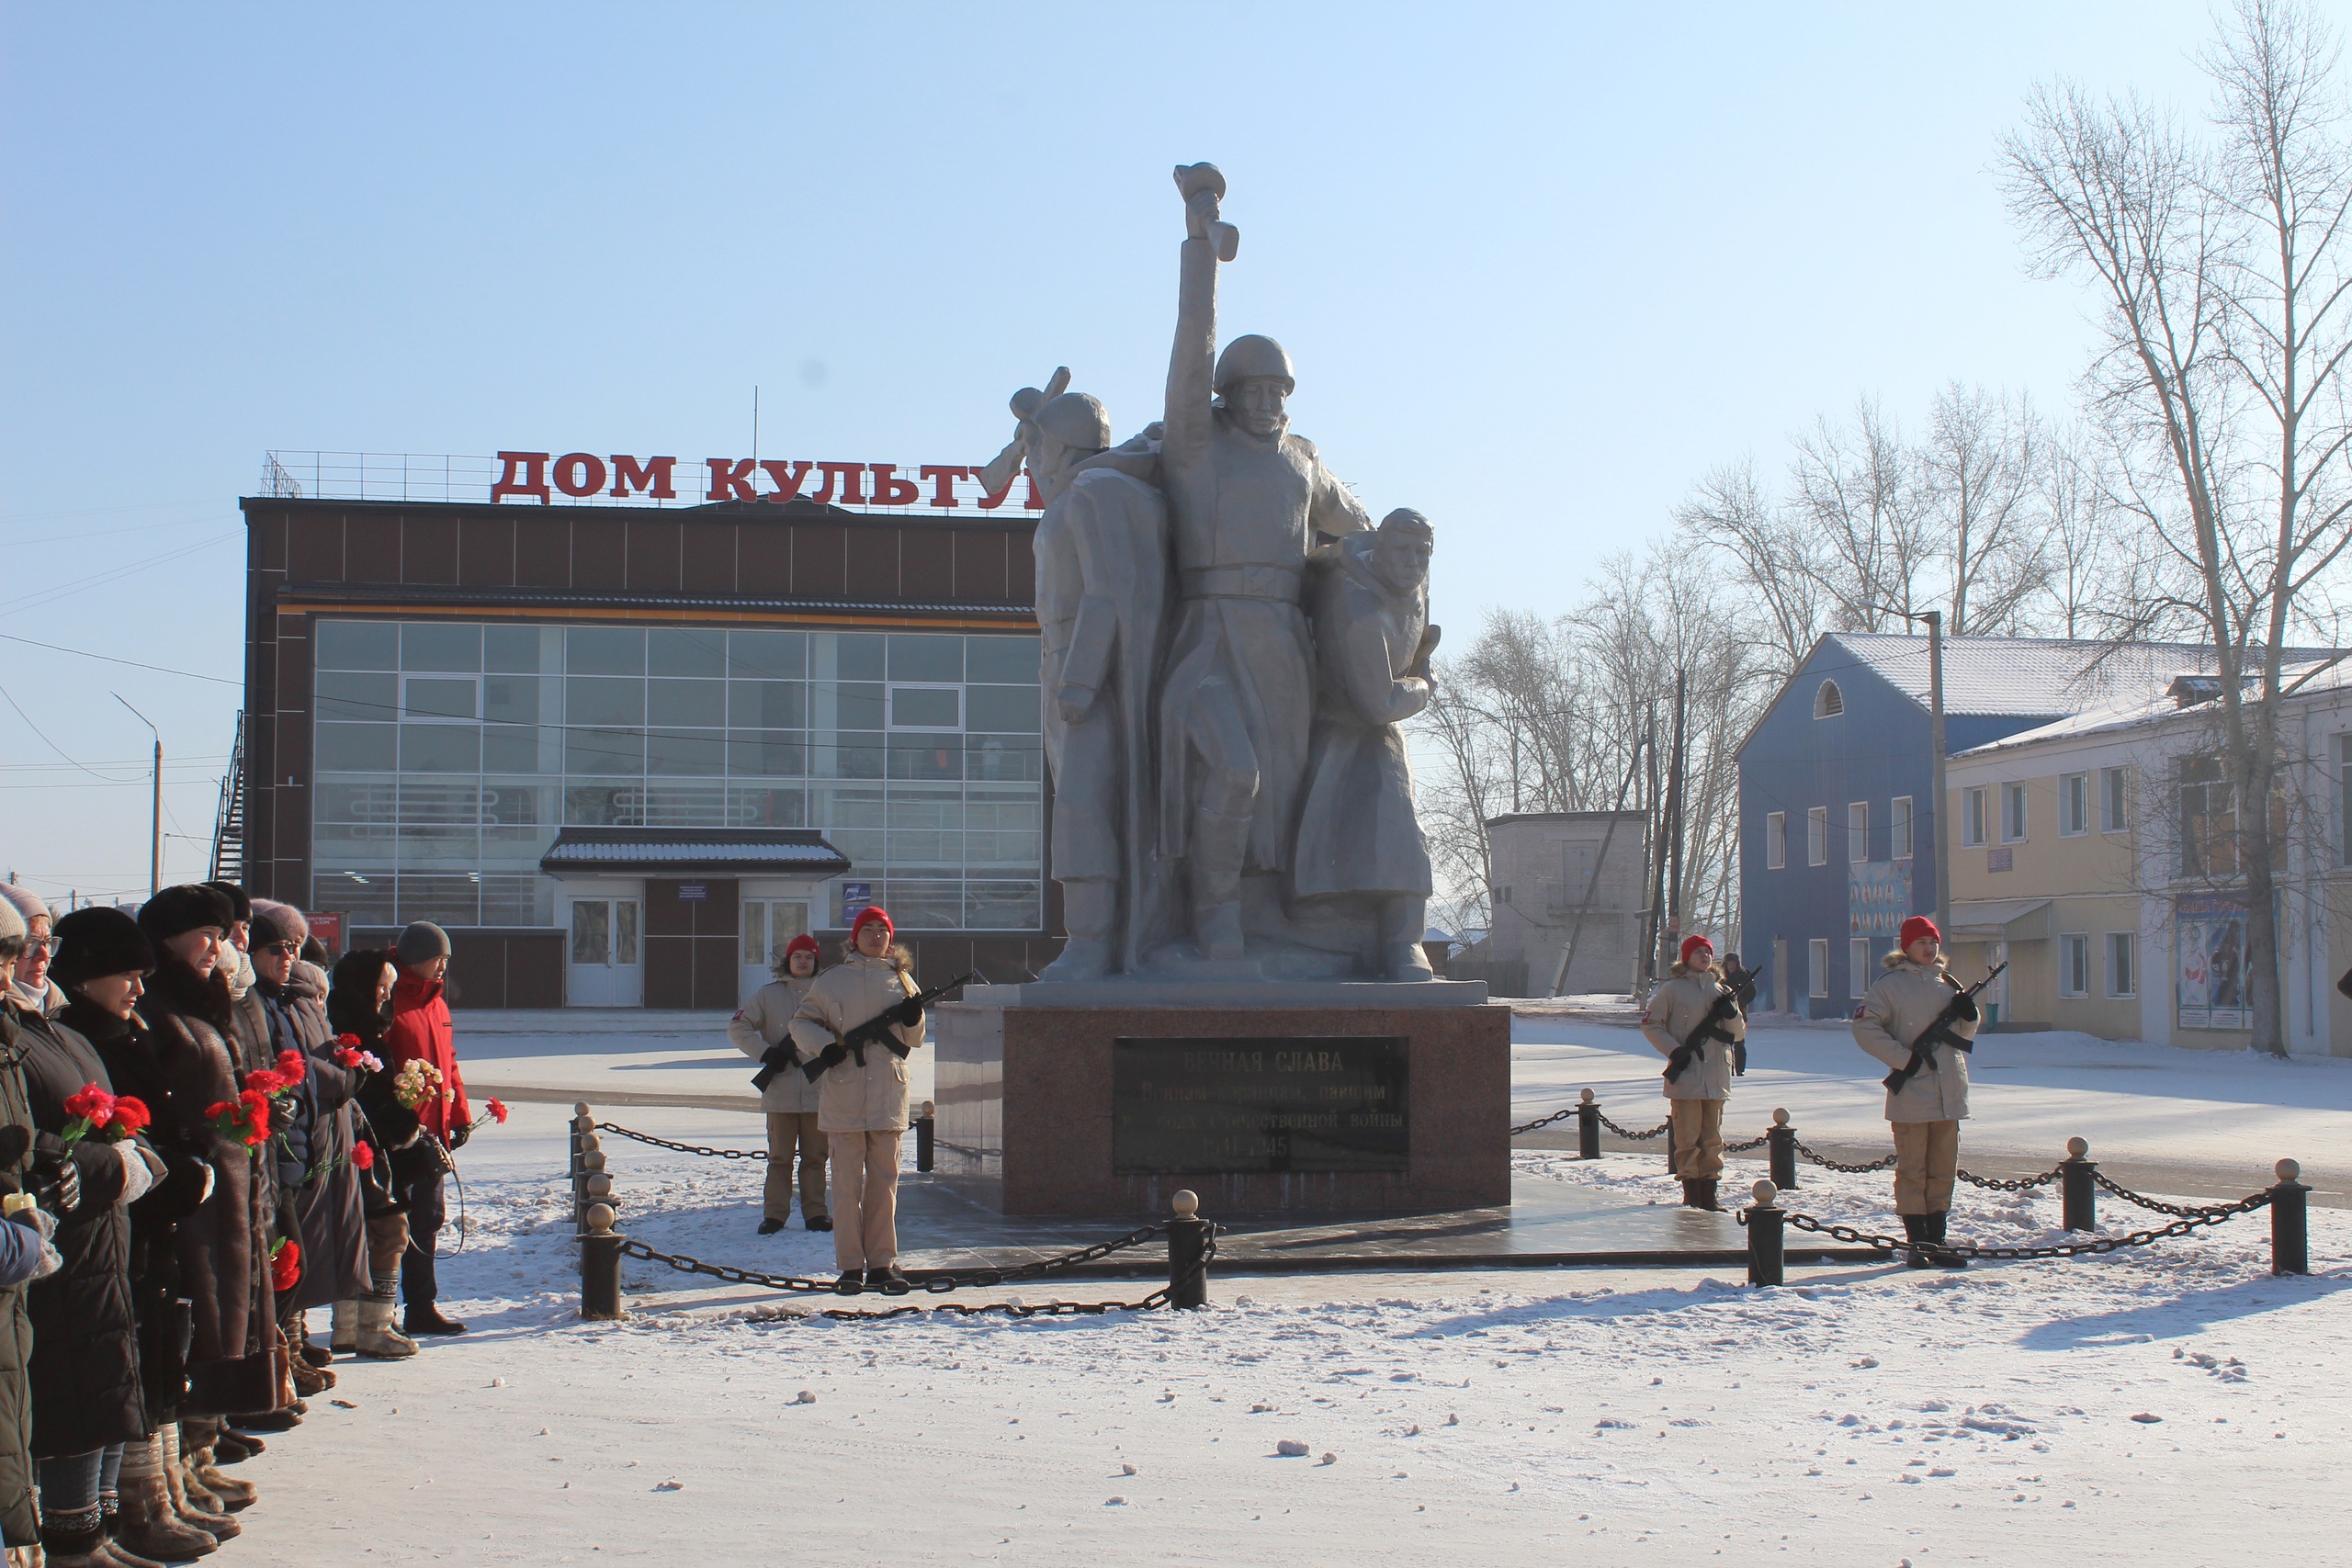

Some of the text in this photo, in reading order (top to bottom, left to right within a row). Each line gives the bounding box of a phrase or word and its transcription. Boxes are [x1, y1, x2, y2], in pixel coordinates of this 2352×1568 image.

[492, 450, 1046, 510] ДОМ КУЛЬТУ
[1182, 1050, 1344, 1072] ВЕЧНАЯ СЛАВА
[1318, 1084, 1386, 1100] павшим
[1350, 1108, 1403, 1129] войны
